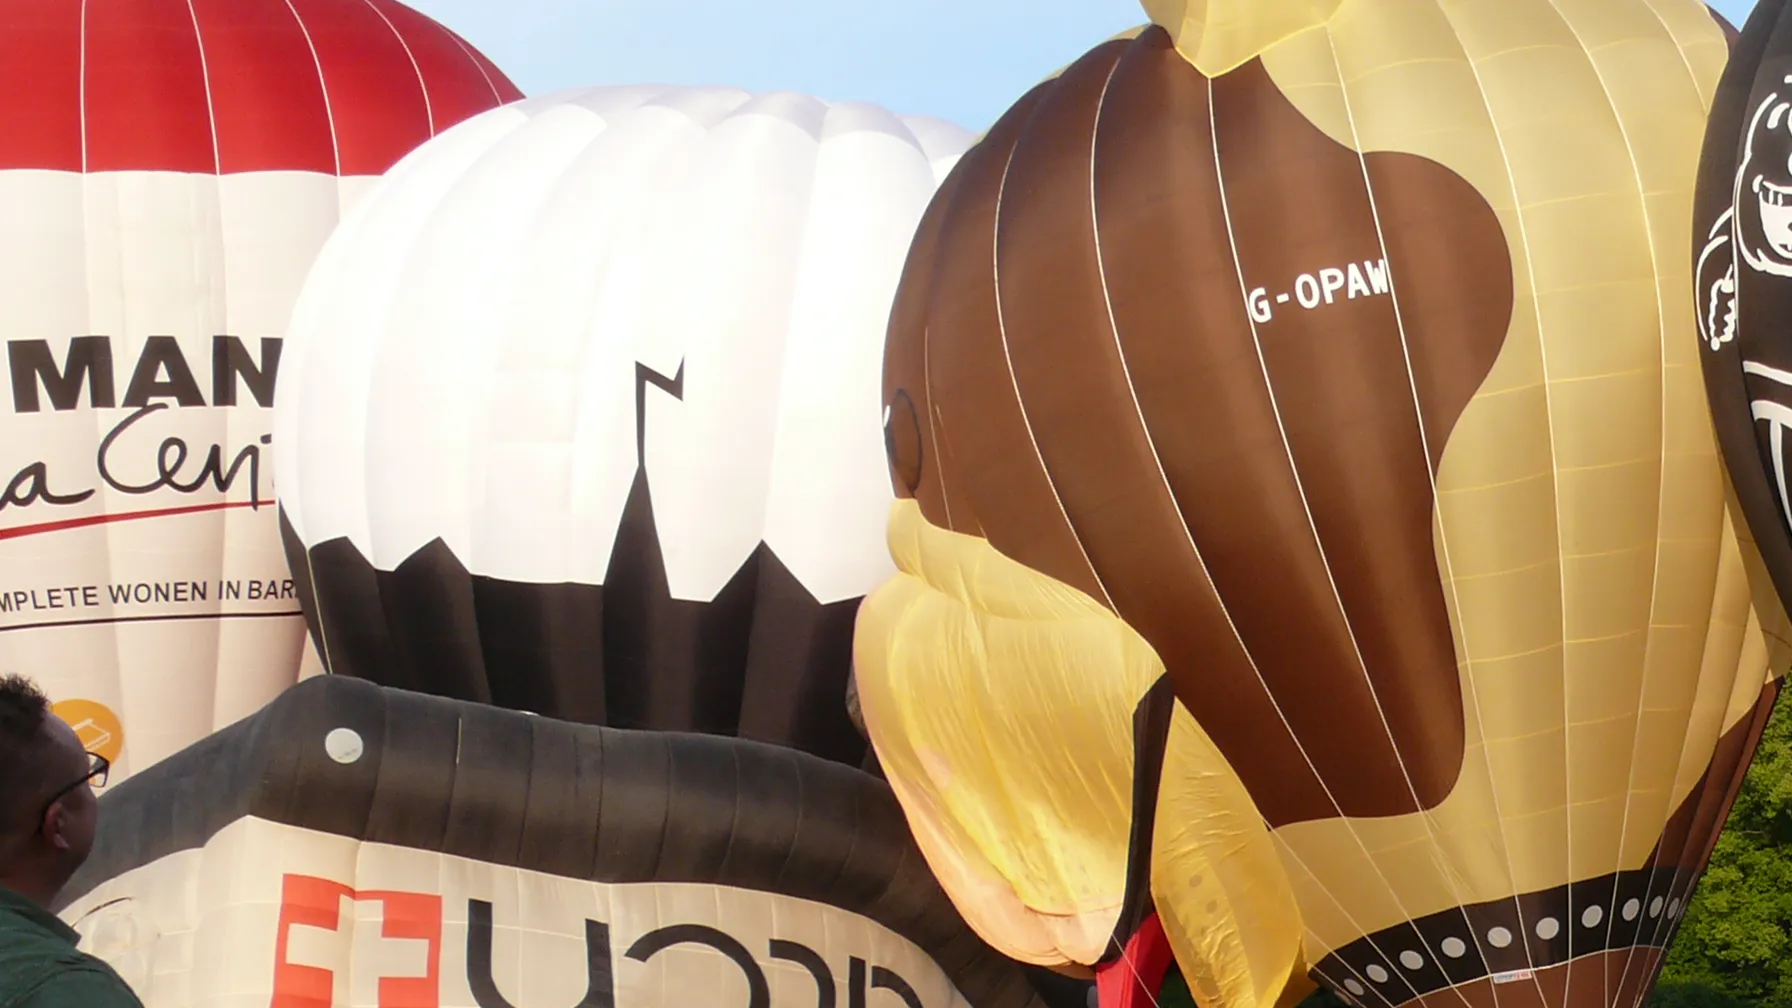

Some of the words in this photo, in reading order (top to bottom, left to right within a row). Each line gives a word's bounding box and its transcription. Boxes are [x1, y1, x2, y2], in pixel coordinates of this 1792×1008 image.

[1248, 259, 1389, 323] G-OPAW
[108, 580, 207, 604] WONEN
[218, 580, 241, 600] IN
